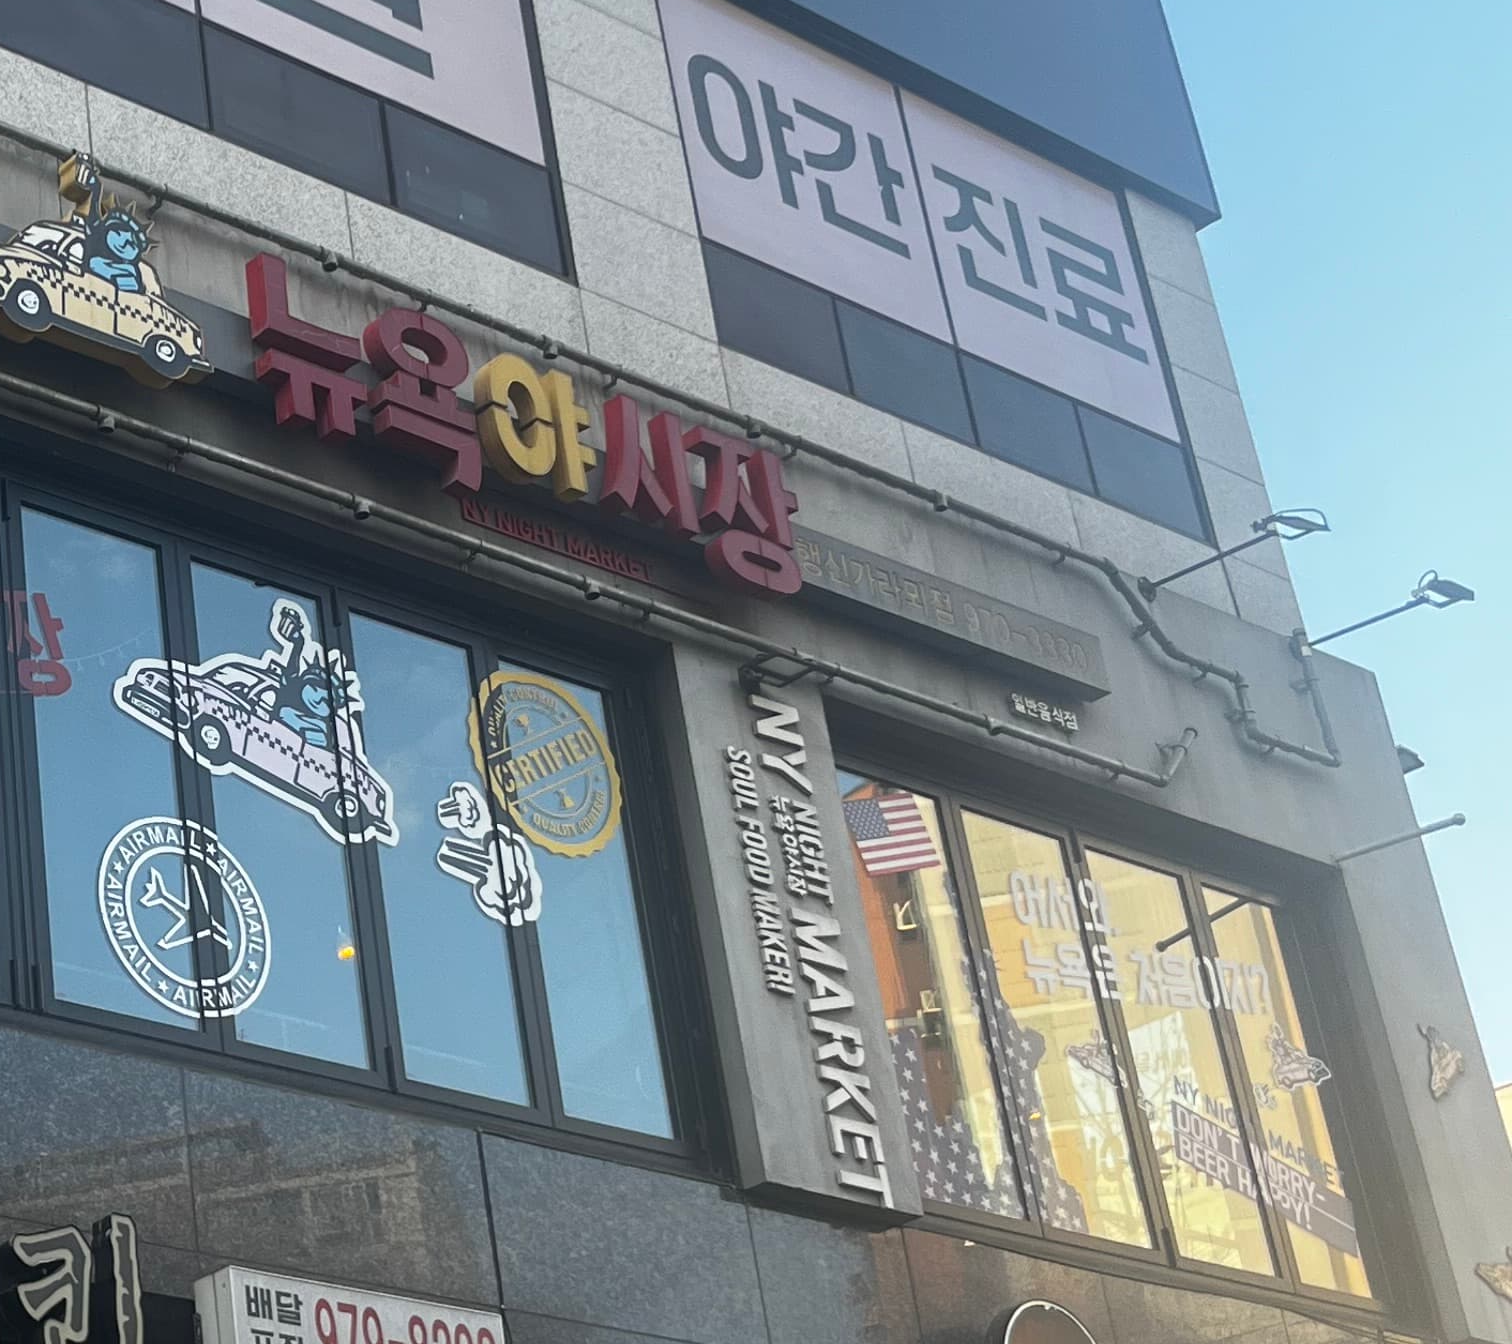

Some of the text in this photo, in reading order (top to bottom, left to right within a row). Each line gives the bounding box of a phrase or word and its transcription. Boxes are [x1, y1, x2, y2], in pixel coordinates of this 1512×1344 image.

[246, 252, 802, 595] 뉴욕야시장
[496, 510, 559, 549] NIGHT
[1009, 691, 1081, 733] 일반음식점
[494, 727, 598, 794] CERTIFIED
[118, 824, 202, 865] AIRMAIL
[723, 744, 796, 997] SOUL FOOD MAKER!
[106, 872, 153, 983] AIRMAIL
[216, 857, 265, 955] AIRMAIL
[747, 694, 894, 1209] NY NIGHT MARKET
[172, 974, 257, 1008] AIRMAIL
[1179, 1137, 1231, 1185] BEER
[244, 1284, 304, 1329] 배달
